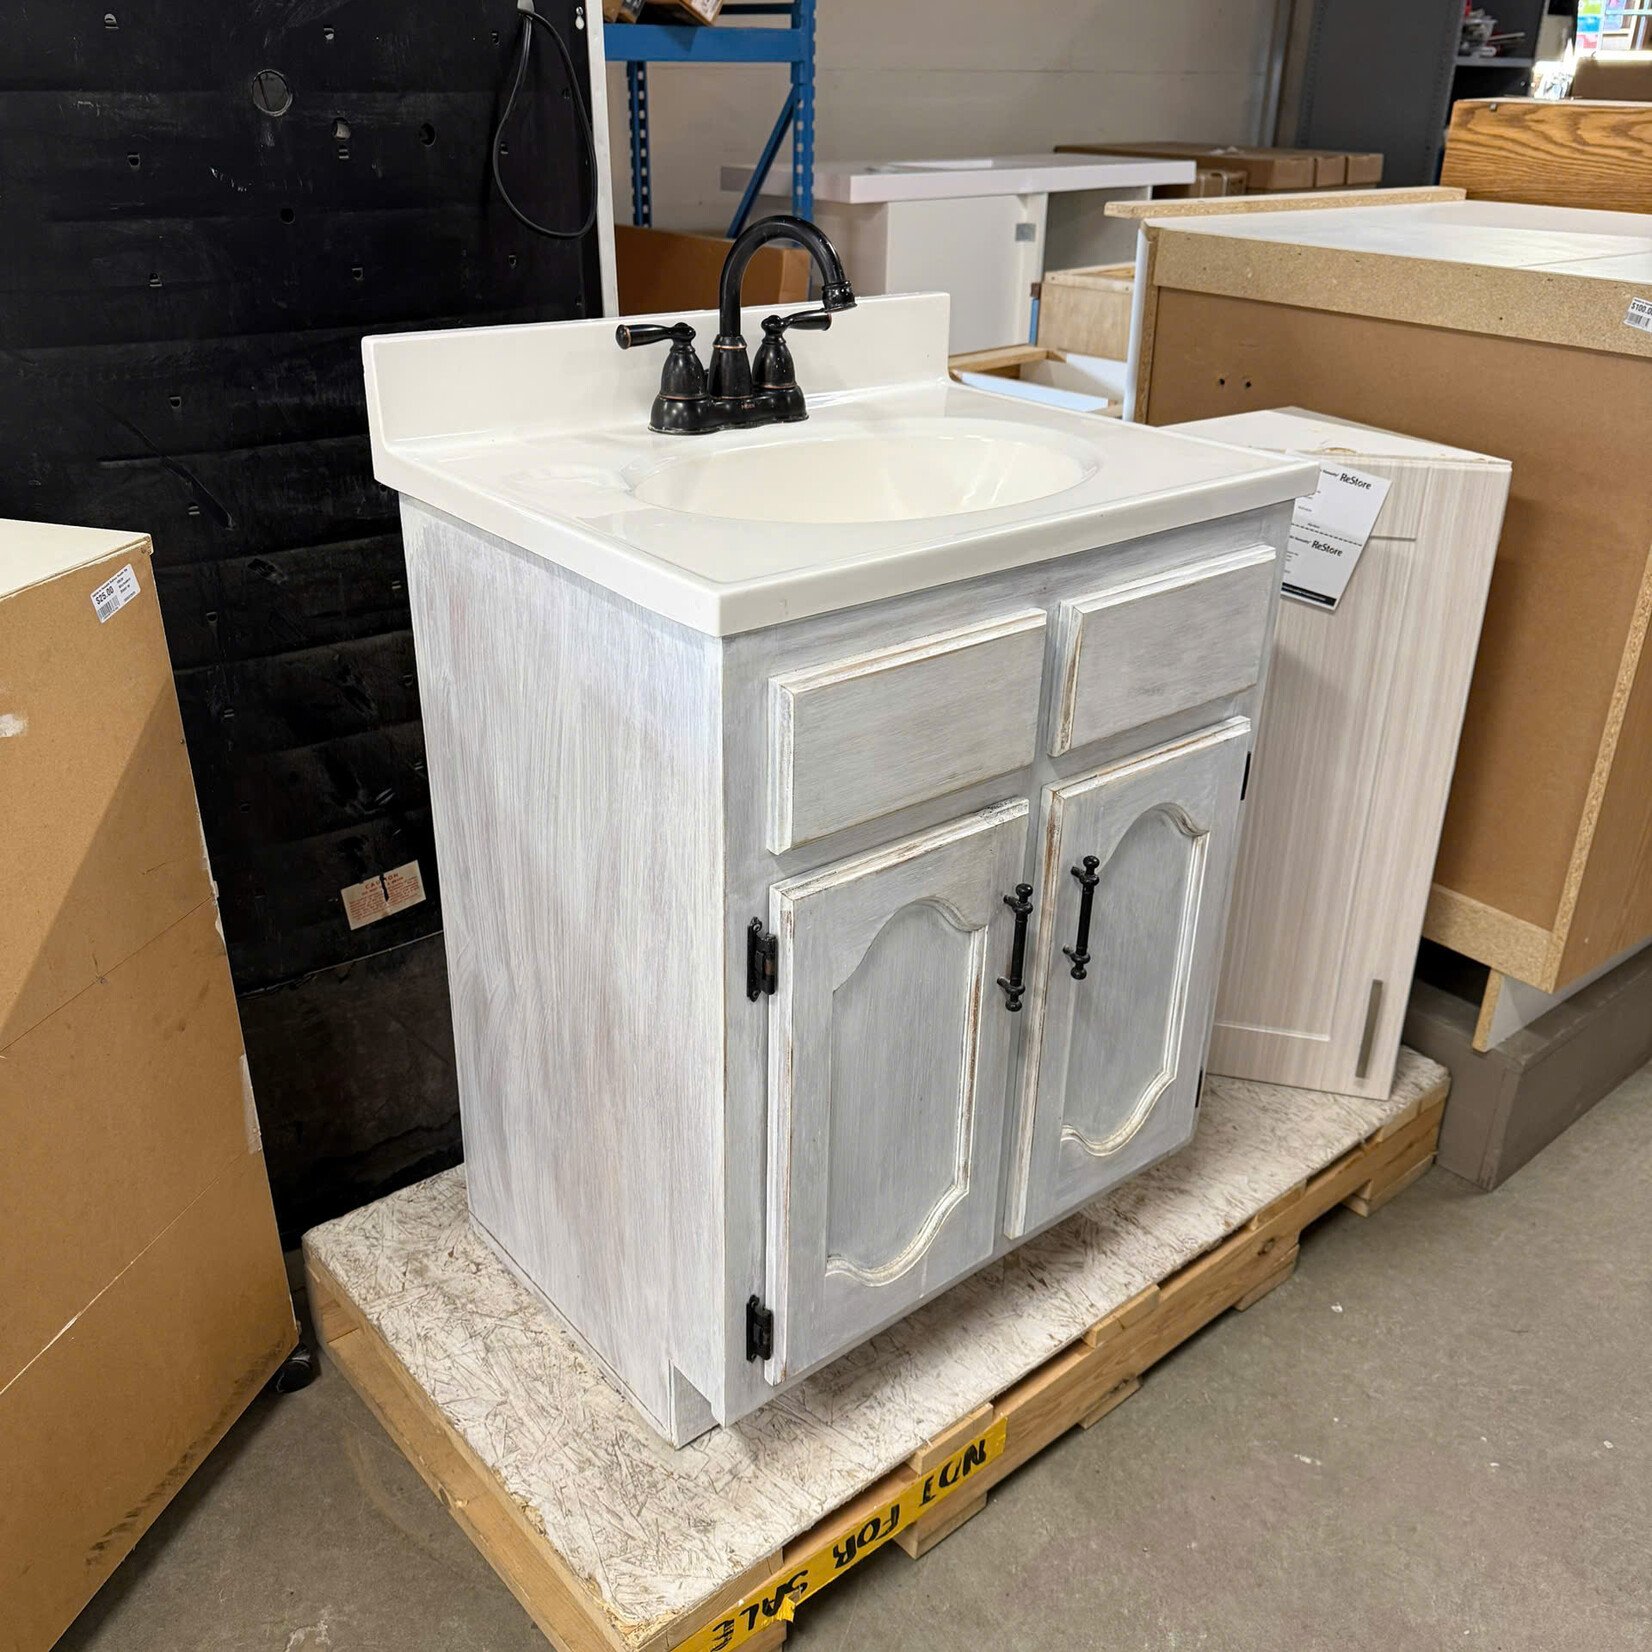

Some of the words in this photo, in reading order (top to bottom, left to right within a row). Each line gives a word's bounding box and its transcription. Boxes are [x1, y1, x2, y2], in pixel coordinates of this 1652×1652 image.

[1631, 302, 1652, 316] $100.0
[1340, 473, 1372, 490] ReStore
[1311, 540, 1343, 557] ReStore
[95, 585, 114, 605] $25.00
[919, 1438, 987, 1506] NOT
[831, 1503, 900, 1569] FOR
